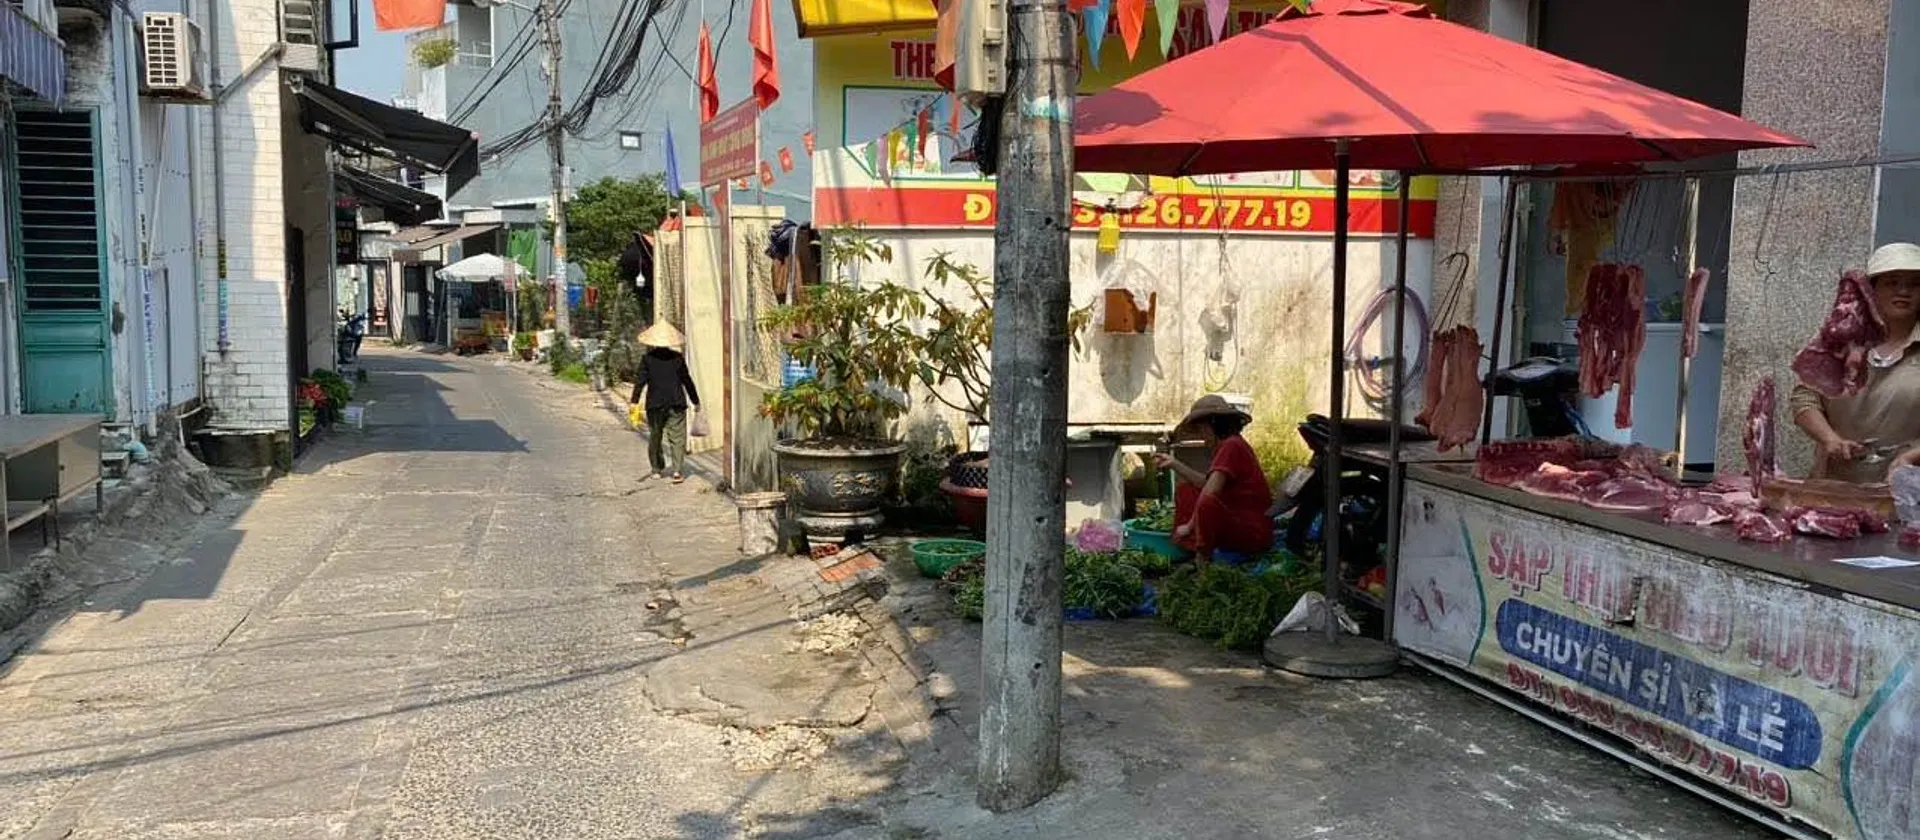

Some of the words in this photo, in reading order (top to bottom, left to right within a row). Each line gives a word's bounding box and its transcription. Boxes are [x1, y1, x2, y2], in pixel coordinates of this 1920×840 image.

[1487, 528, 1554, 598] SẠP
[1516, 622, 1633, 693] CHUYÊN
[1638, 661, 1672, 705] SỈ
[1736, 701, 1787, 752] LẺ
